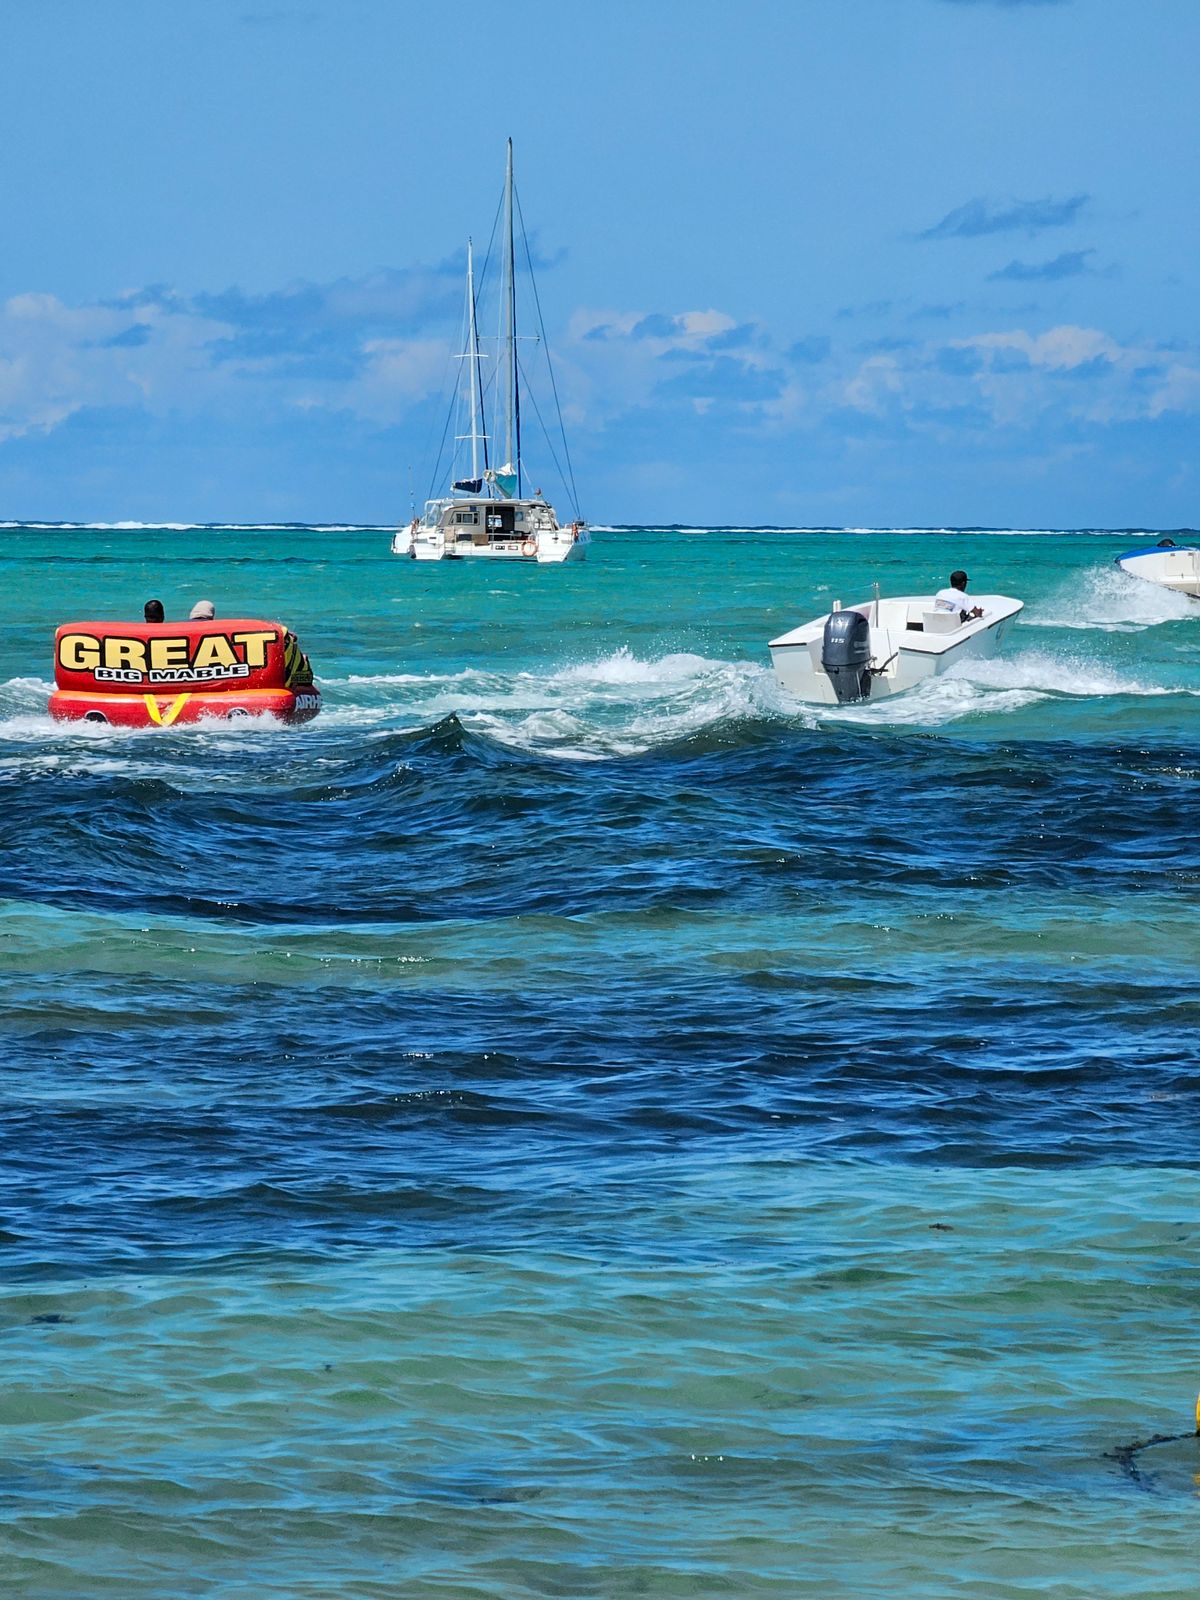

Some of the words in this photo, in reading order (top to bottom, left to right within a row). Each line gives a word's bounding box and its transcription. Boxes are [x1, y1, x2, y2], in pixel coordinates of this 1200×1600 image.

[60, 633, 276, 672] GREAT
[95, 667, 142, 682] BIG
[149, 664, 248, 683] MABLE
